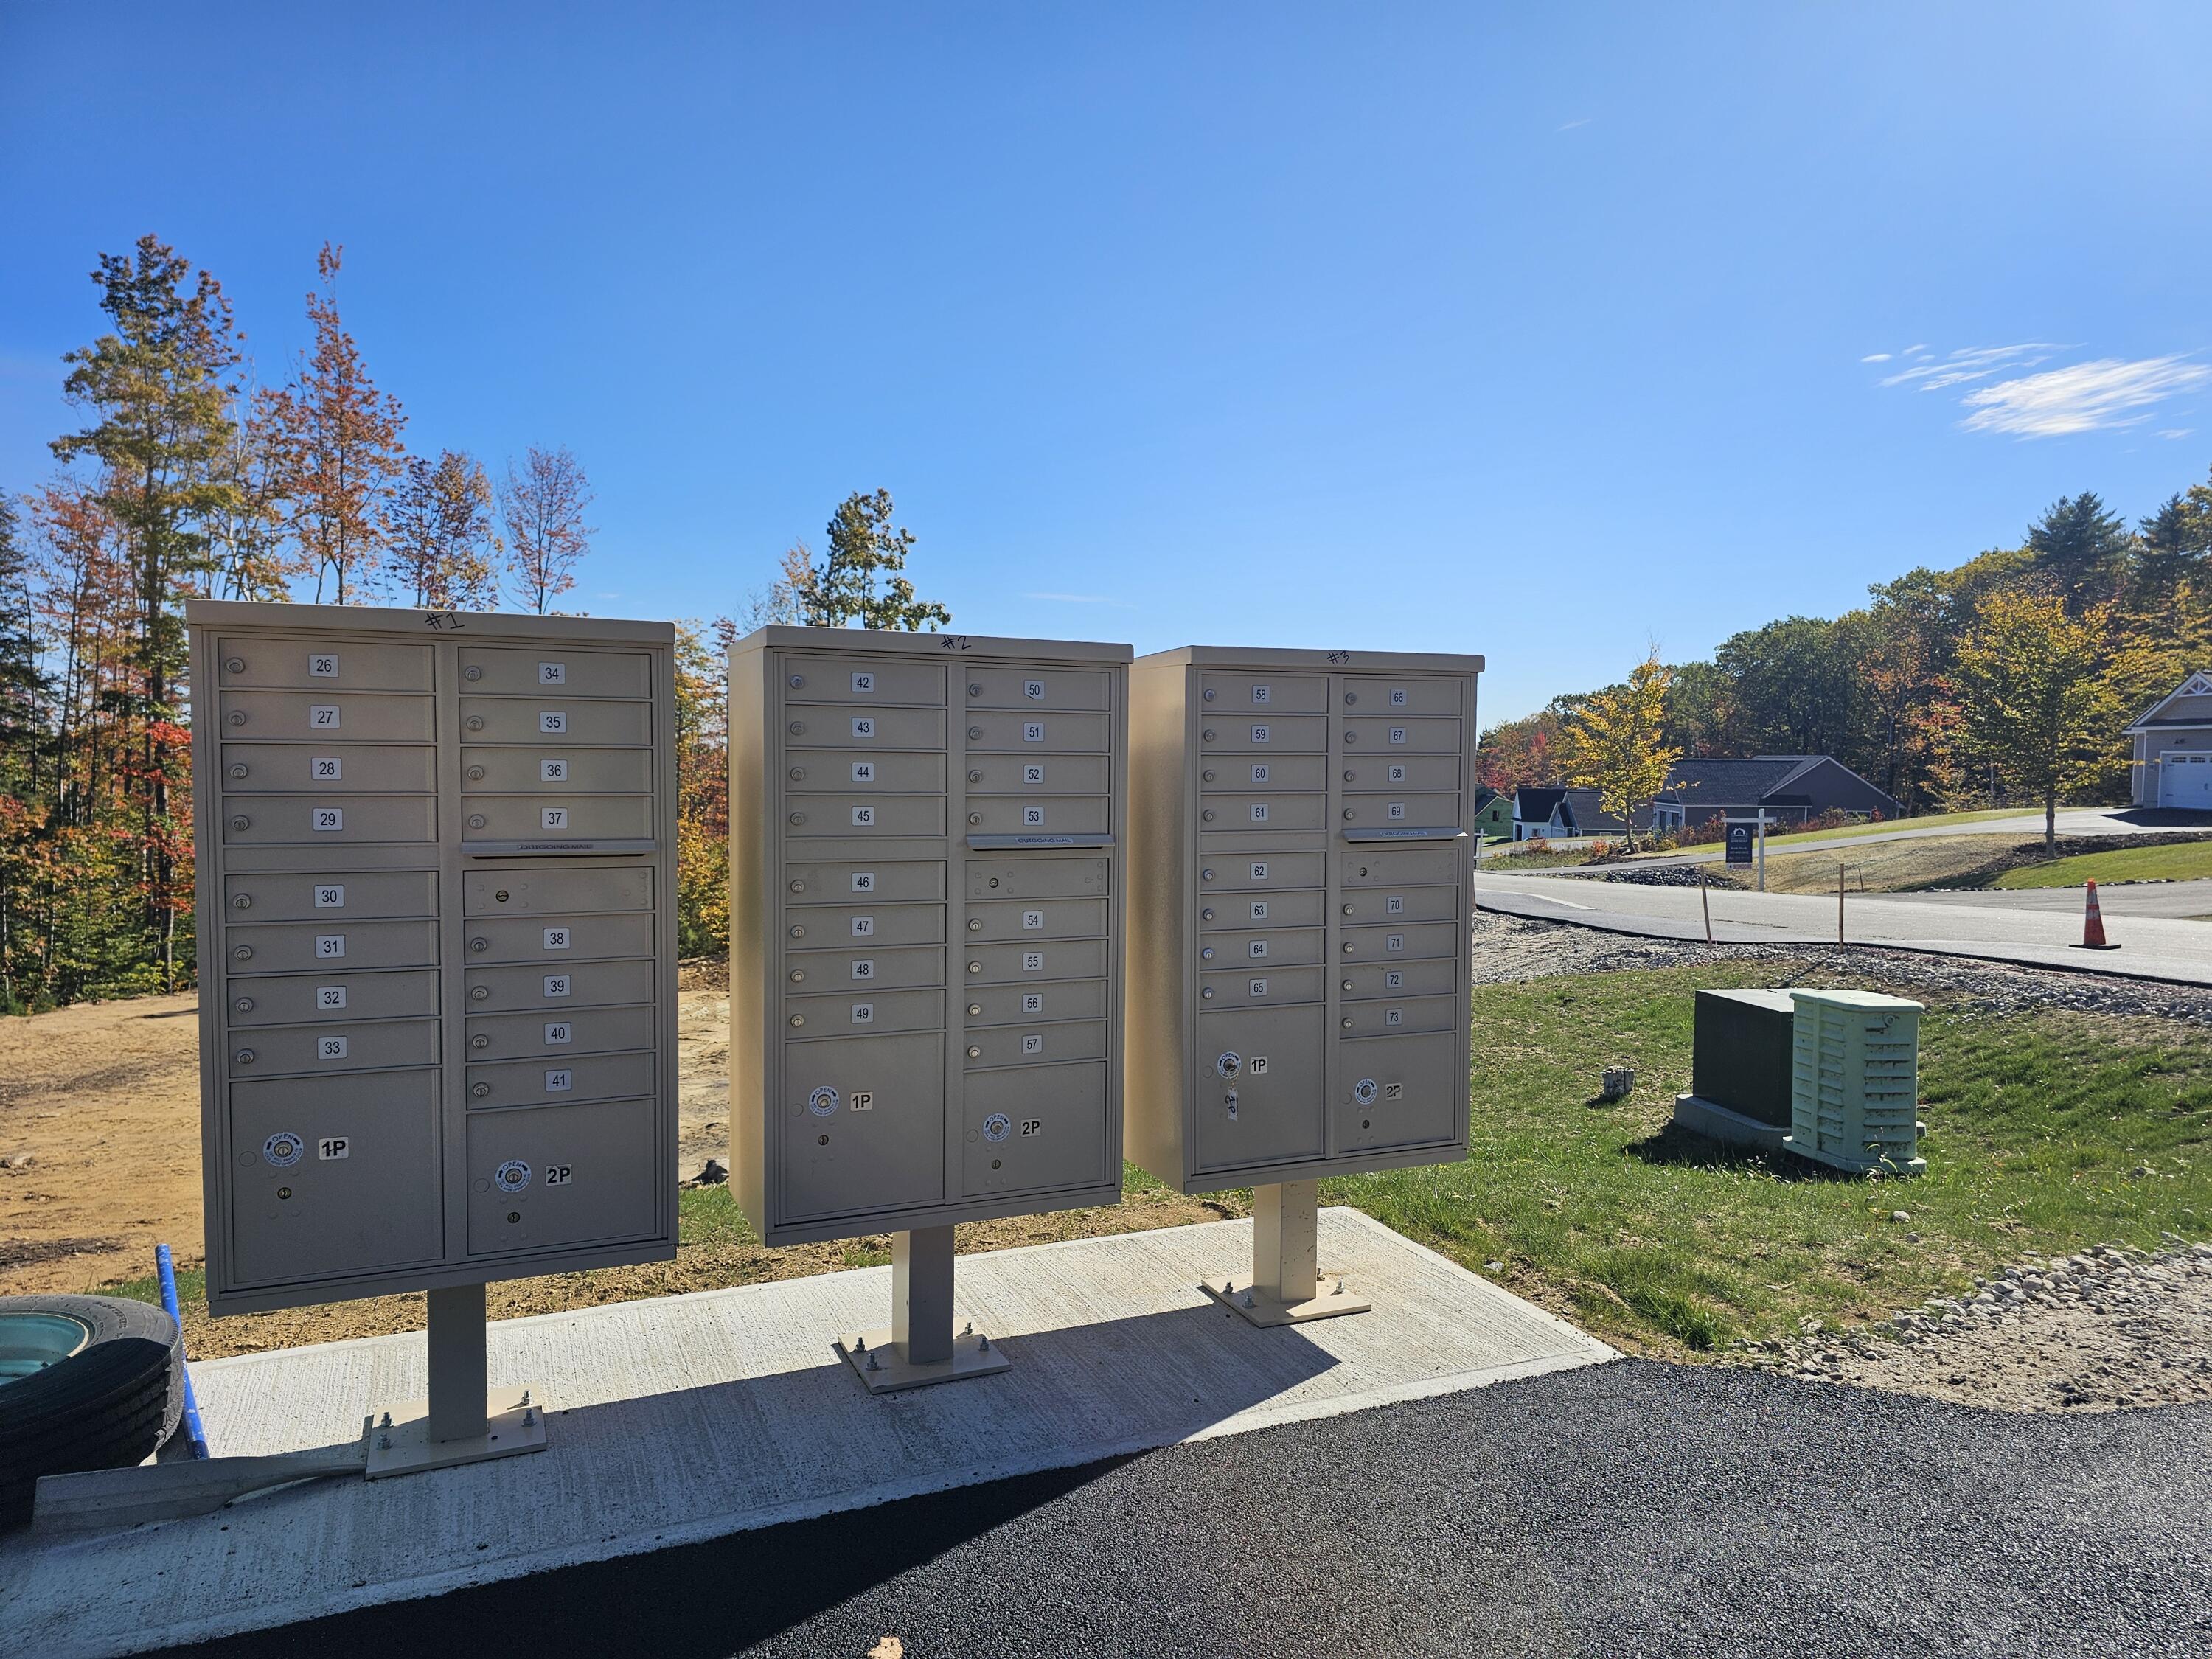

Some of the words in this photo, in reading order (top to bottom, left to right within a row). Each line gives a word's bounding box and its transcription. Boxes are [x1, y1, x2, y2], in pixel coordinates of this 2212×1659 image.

[425, 613, 465, 630] #1
[940, 636, 972, 650] #2
[1326, 650, 1349, 664] #3
[316, 658, 332, 672] 26
[545, 667, 560, 680] 34
[856, 676, 869, 689] 42
[1029, 684, 1040, 696] 50
[1256, 689, 1266, 700] 58
[1394, 692, 1403, 703] 66
[317, 710, 333, 724] 27
[546, 716, 560, 728] 35
[857, 721, 869, 734] 43
[1029, 726, 1039, 738] 51
[1256, 728, 1266, 740] 59
[1393, 731, 1403, 741] 67
[319, 762, 335, 776] 28
[547, 764, 562, 777] 36
[857, 766, 869, 778] 44
[1028, 768, 1040, 779] 52
[1255, 768, 1265, 779] 60
[1392, 768, 1402, 779] 68
[857, 810, 869, 822] 45
[1028, 810, 1040, 822] 53
[1255, 807, 1265, 818] 61
[1391, 806, 1401, 816] 69
[320, 813, 336, 826] 29
[548, 812, 562, 825] 37
[1254, 866, 1265, 877] 62
[857, 876, 869, 888] 46
[321, 889, 338, 903] 30
[1254, 905, 1264, 916] 63
[1391, 900, 1400, 911] 70
[856, 920, 869, 932] 47
[1027, 914, 1039, 926] 54
[549, 932, 564, 945] 38
[1391, 938, 1399, 948] 71
[324, 940, 338, 953] 31
[1253, 944, 1264, 955] 64
[1027, 956, 1039, 967] 55
[856, 964, 869, 975] 48
[550, 979, 565, 992] 39
[1390, 975, 1399, 985] 72
[1253, 982, 1264, 993] 65
[324, 991, 340, 1004] 32
[1027, 998, 1038, 1009] 56
[856, 1007, 869, 1020] 49
[1389, 1012, 1399, 1022] 73
[551, 1026, 566, 1040] 40
[324, 1041, 341, 1055] 33
[1026, 1038, 1037, 1050] 57
[1251, 1059, 1266, 1071] 1P
[552, 1074, 565, 1087] 41
[852, 1094, 871, 1109] 1P
[1022, 1121, 1040, 1135] 2P
[272, 1133, 293, 1142] OPEN
[321, 1140, 346, 1157] 1P
[502, 1161, 522, 1170] OPEN
[547, 1167, 571, 1183] 2P
